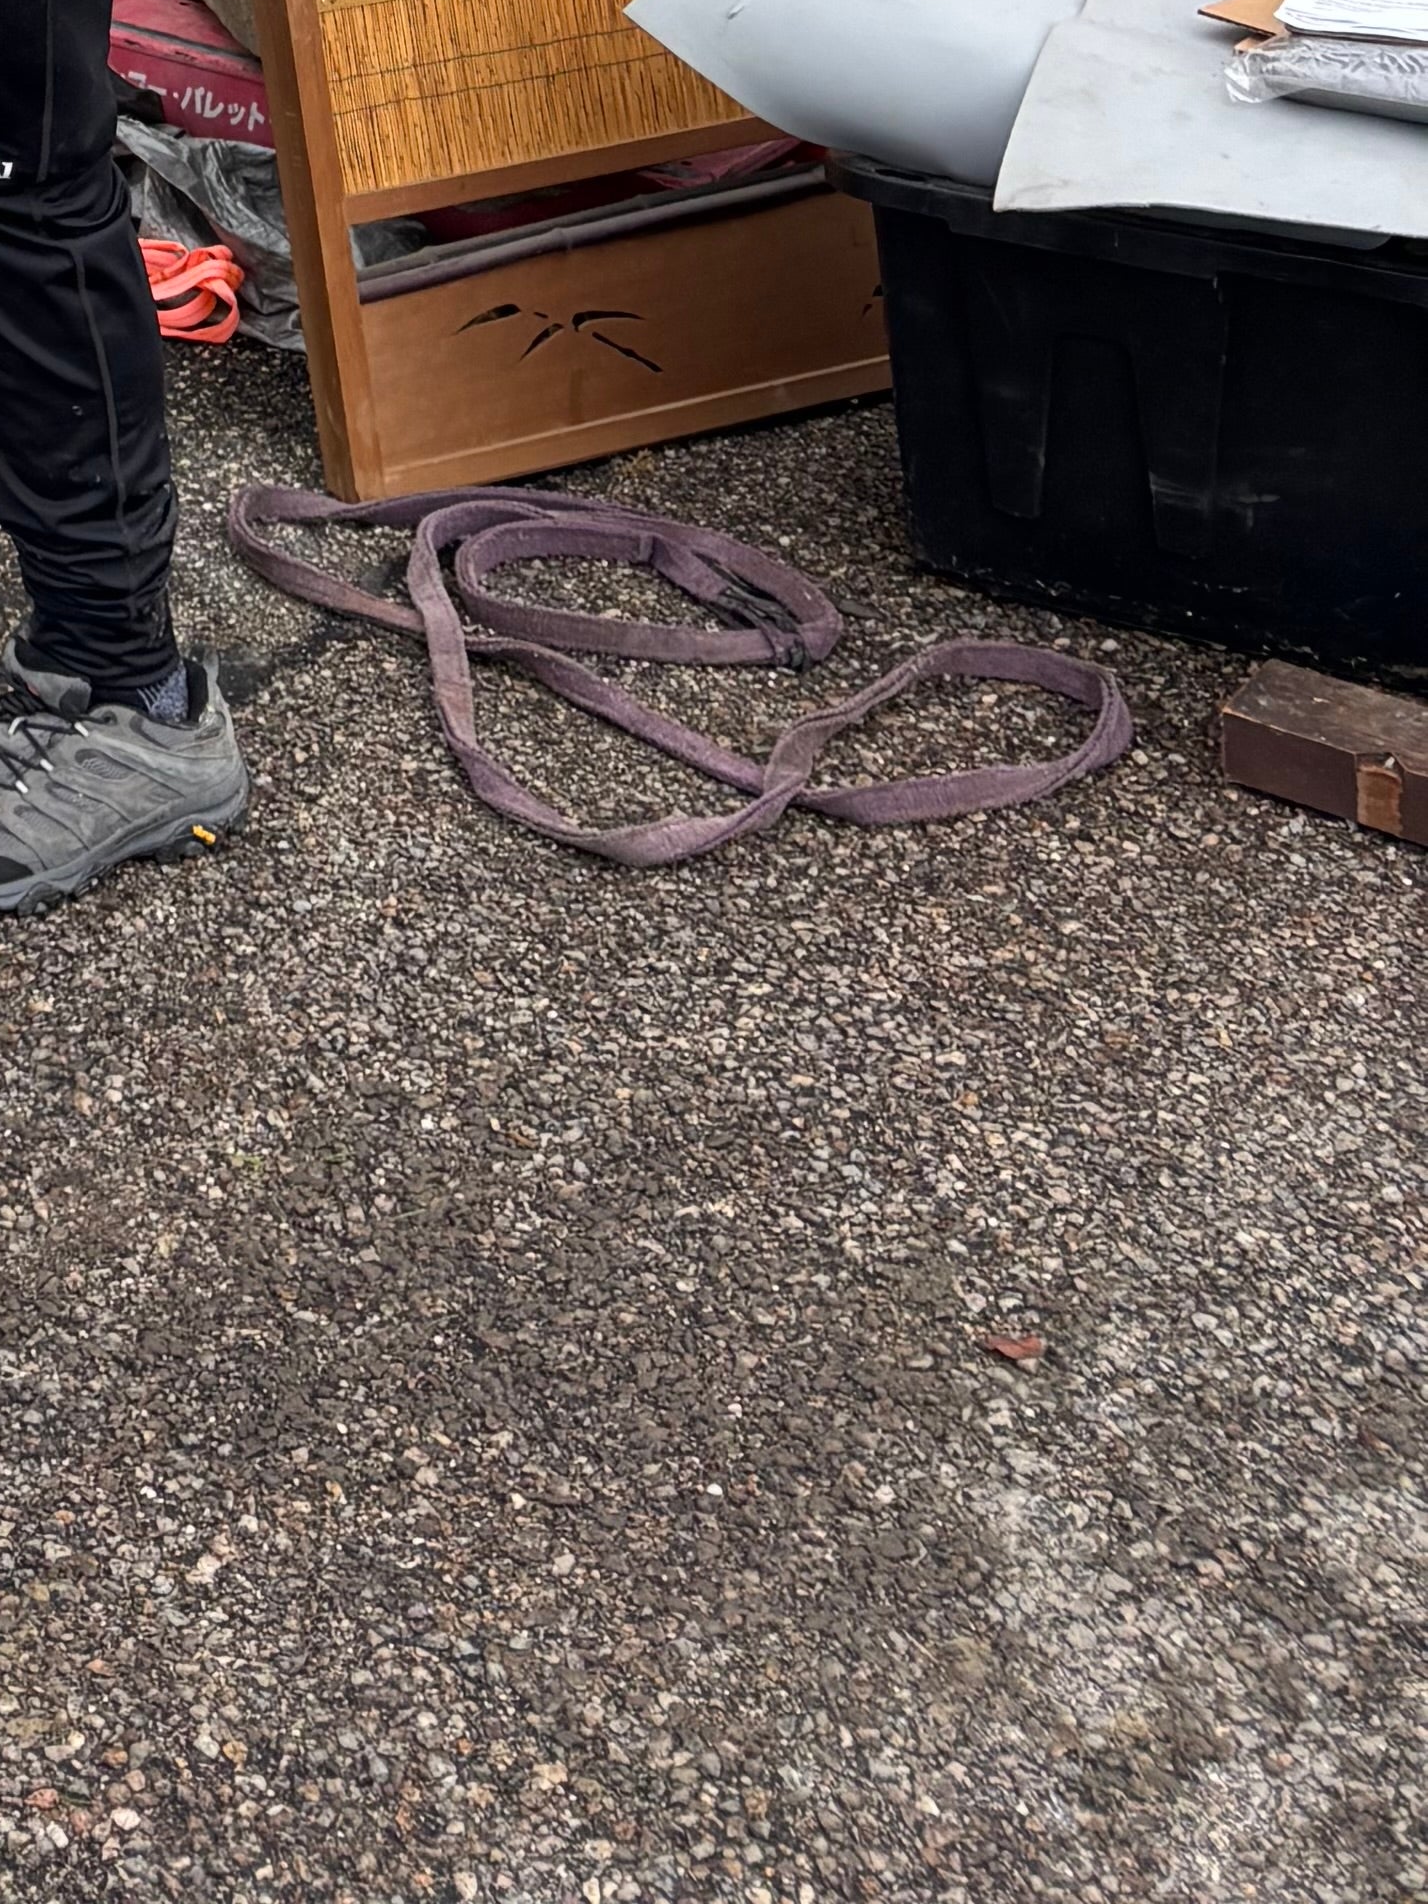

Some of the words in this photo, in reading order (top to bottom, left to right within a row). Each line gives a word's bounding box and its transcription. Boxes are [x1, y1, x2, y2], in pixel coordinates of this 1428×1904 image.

[120, 70, 265, 132] コー・パレット
